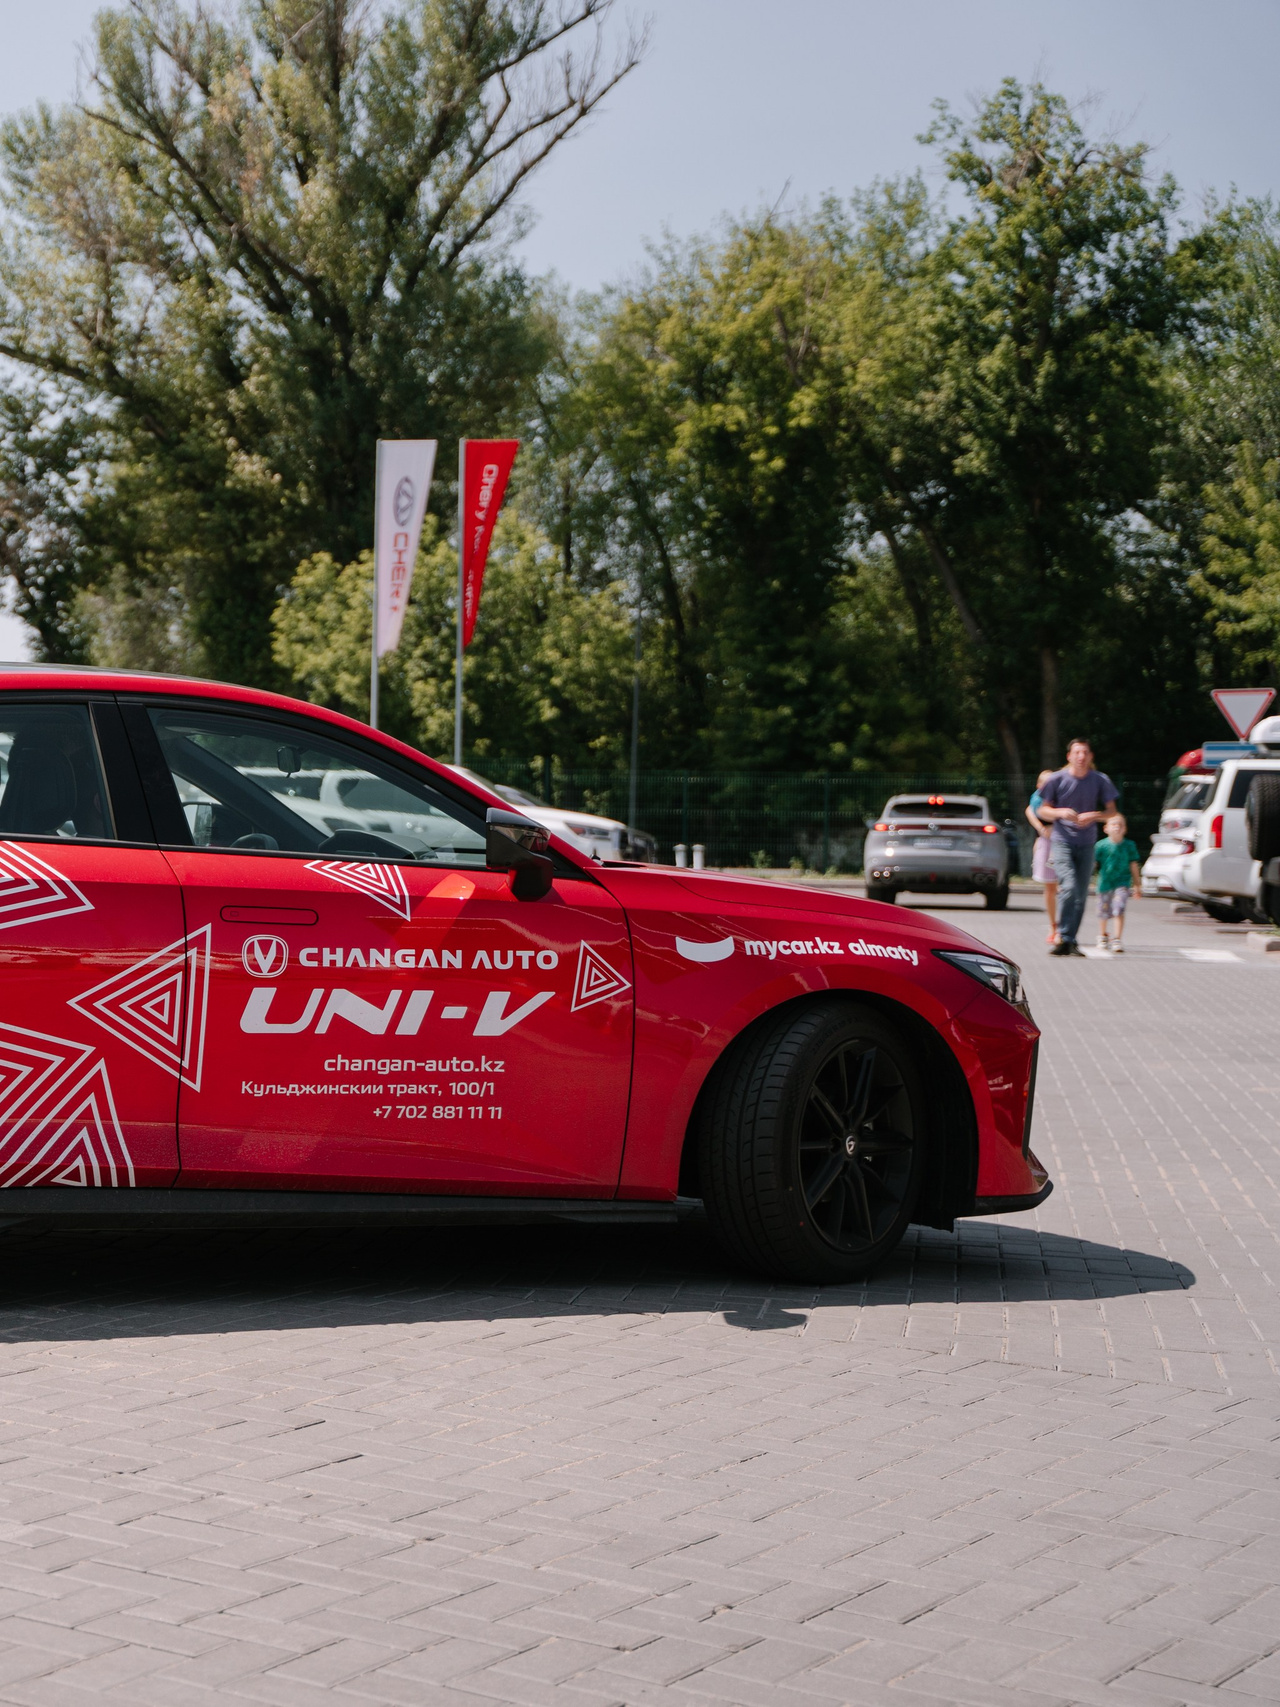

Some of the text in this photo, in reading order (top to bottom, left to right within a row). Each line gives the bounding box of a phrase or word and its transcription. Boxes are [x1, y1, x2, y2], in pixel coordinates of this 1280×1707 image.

[298, 947, 559, 970] CHANGAN AUTO
[743, 936, 919, 966] mycar.kz almaty
[239, 987, 556, 1037] UNI-V
[323, 1054, 505, 1075] changan-auto.kz
[387, 1084, 442, 1097] тракт,
[449, 1081, 495, 1097] 100/1
[373, 1105, 502, 1120] +7 702 881 11 11
